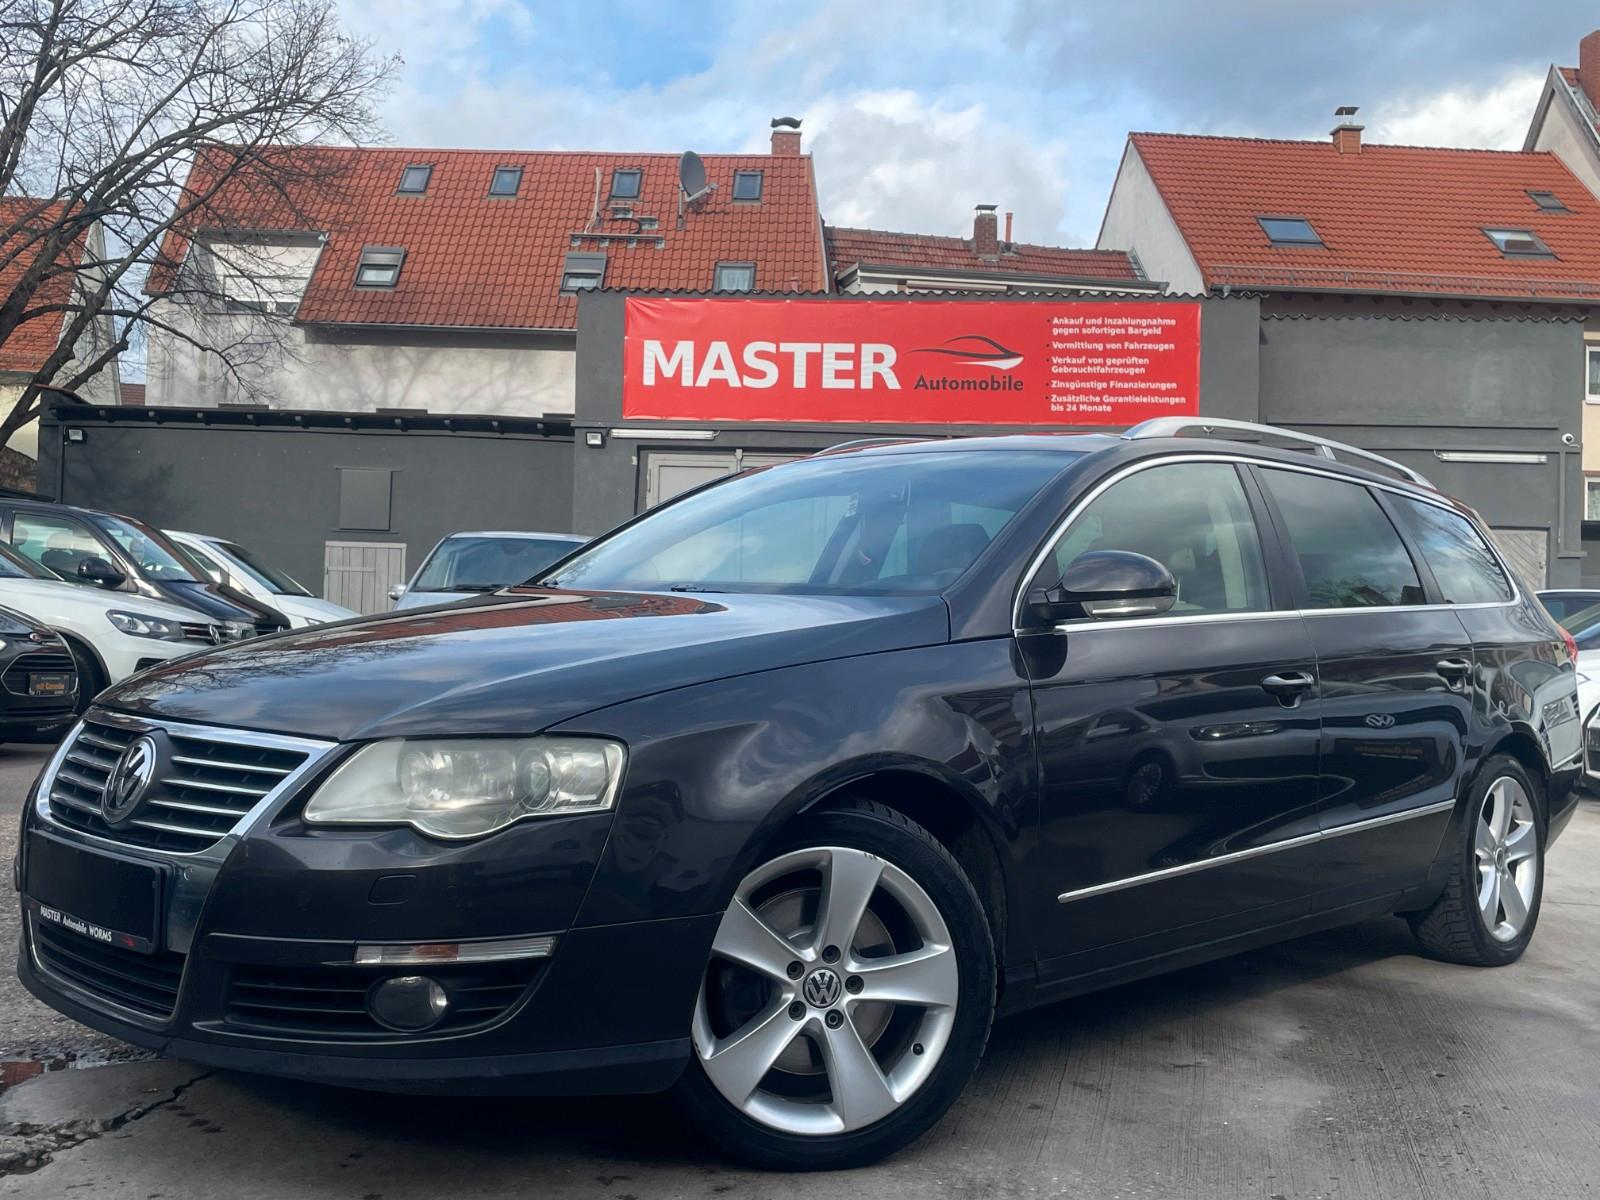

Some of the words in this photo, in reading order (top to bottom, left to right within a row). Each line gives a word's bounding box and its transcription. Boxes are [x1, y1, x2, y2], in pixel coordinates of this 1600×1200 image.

[1052, 317, 1083, 326] Ankauf
[1085, 317, 1102, 326] und
[1104, 317, 1177, 328] Inzahlungnahme
[1052, 327, 1079, 336] gegen
[1081, 327, 1126, 336] sofortiges
[1127, 327, 1162, 336] Bargeld
[1052, 341, 1104, 351] Vermittlung
[1124, 342, 1175, 351] Fahrzeugen
[642, 340, 901, 390] MASTER
[1052, 356, 1086, 365] Verkauf
[1106, 357, 1150, 366] geprüften
[1051, 365, 1146, 375] Gebrauchtfahrzeugen
[914, 374, 1024, 391] Automobile
[1051, 380, 1108, 390] Zinsgünstige
[1109, 381, 1177, 390] Finanzierungen
[1050, 394, 1101, 403] Zusätzliche
[1102, 395, 1186, 404] Garantieleistungen
[1050, 404, 1064, 412] bis
[1066, 404, 1077, 412] 24
[1079, 404, 1112, 413] Monate
[40, 904, 61, 923] MASTER
[62, 915, 87, 934] Automobile
[88, 925, 113, 942] WORMS
